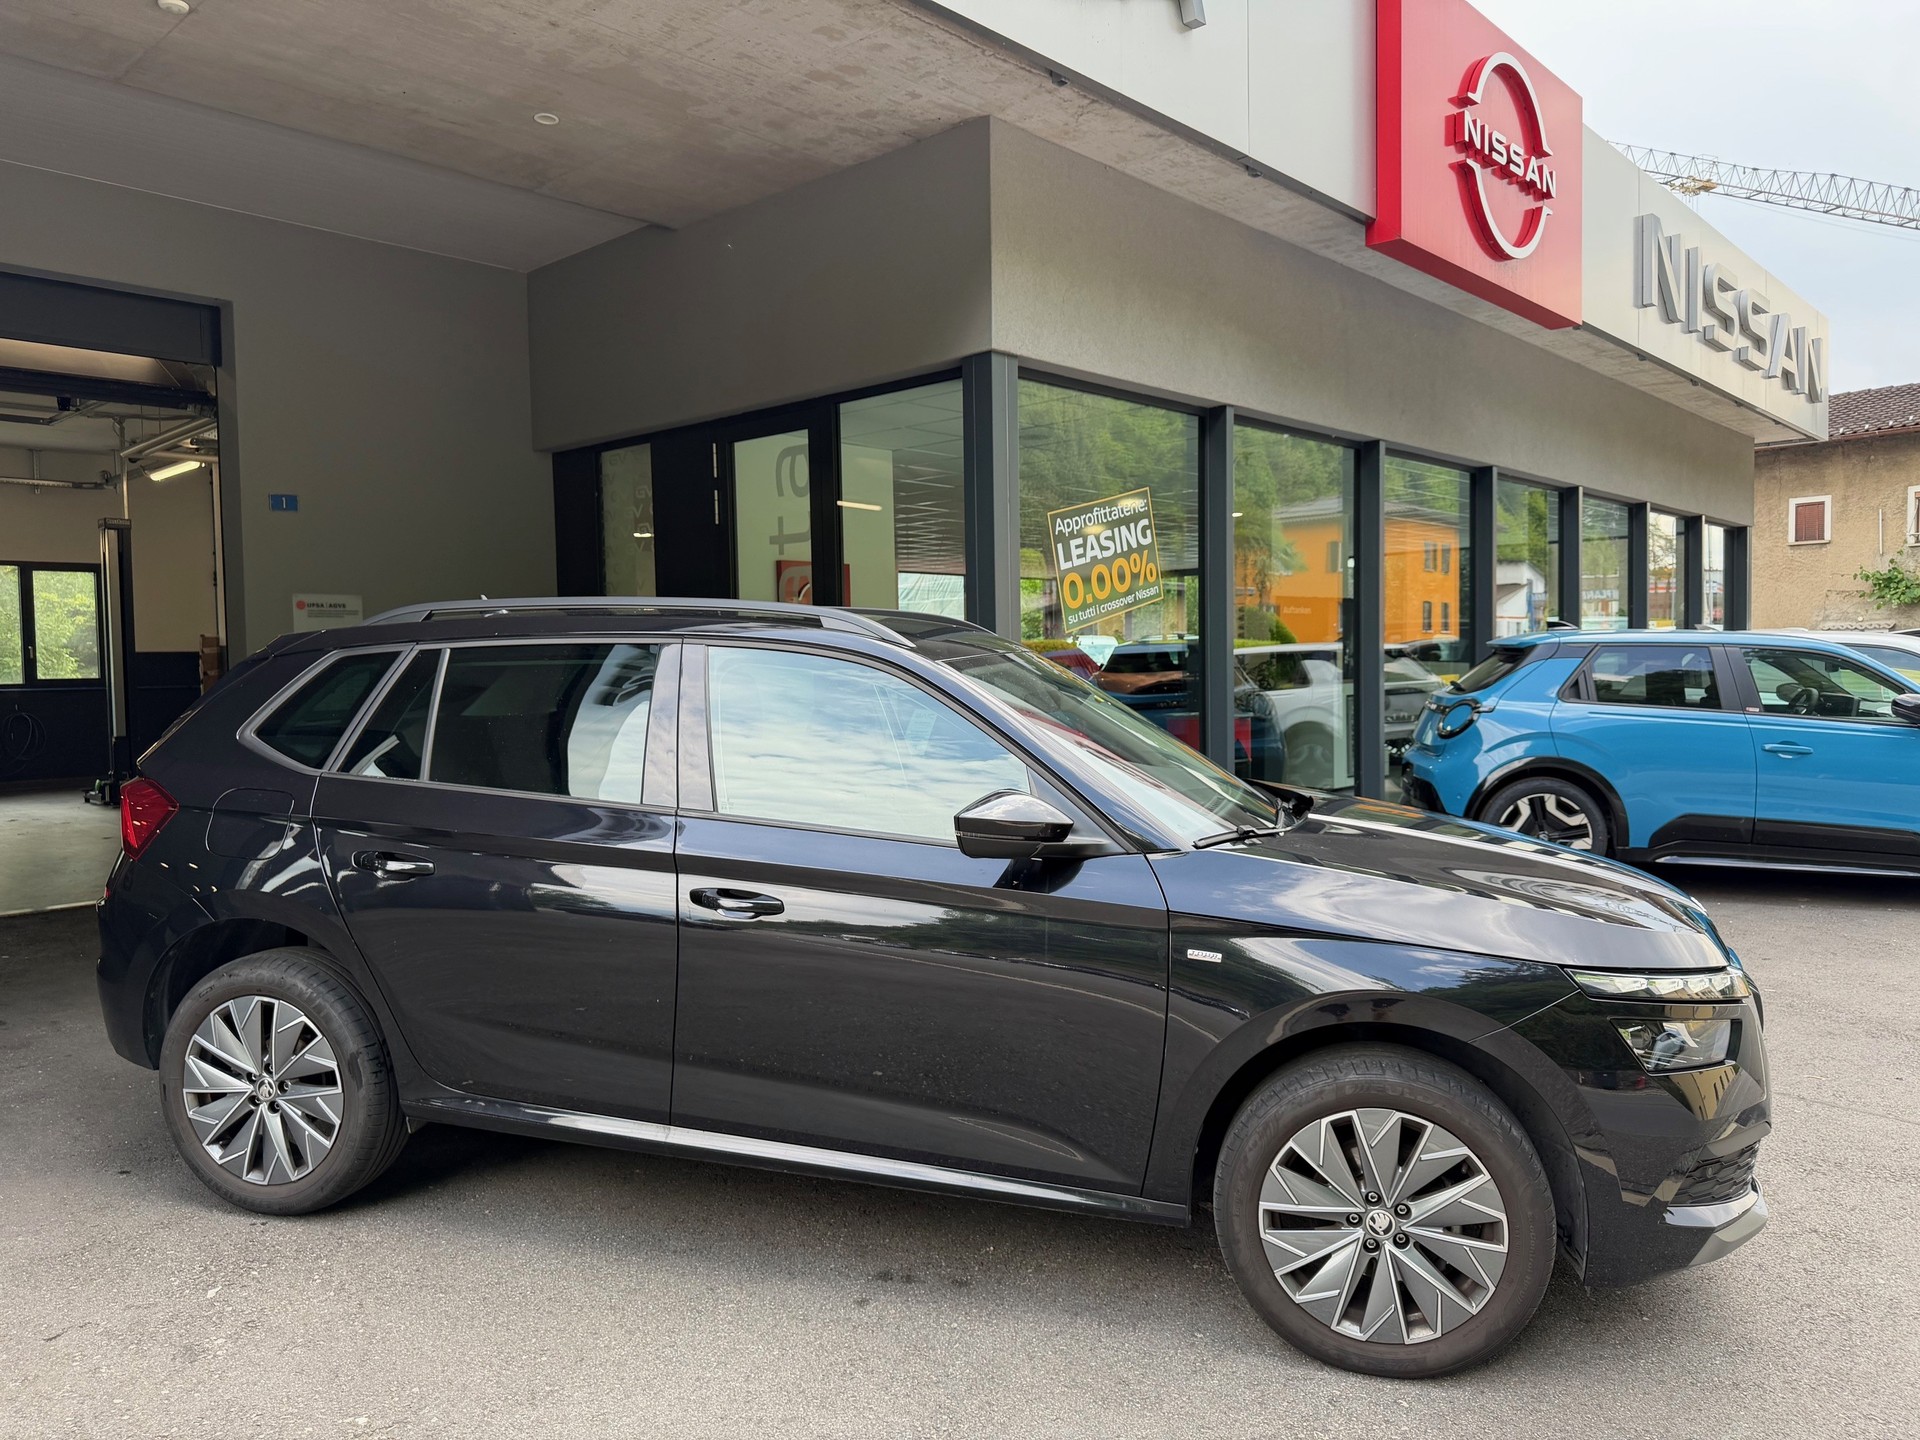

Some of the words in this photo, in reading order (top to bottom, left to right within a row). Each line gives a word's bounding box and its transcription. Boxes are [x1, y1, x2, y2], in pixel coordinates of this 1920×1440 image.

[1461, 110, 1557, 200] NISSAN
[1634, 213, 1823, 404] NISSAN
[281, 497, 286, 509] 1
[1055, 499, 1148, 536] Approfittatene:
[1057, 518, 1152, 570] LEASING
[1063, 550, 1157, 609] 0.00%
[1068, 613, 1078, 624] su
[1078, 605, 1096, 620] tutti
[1100, 594, 1134, 612] crossover
[1136, 585, 1159, 601] Nissan
